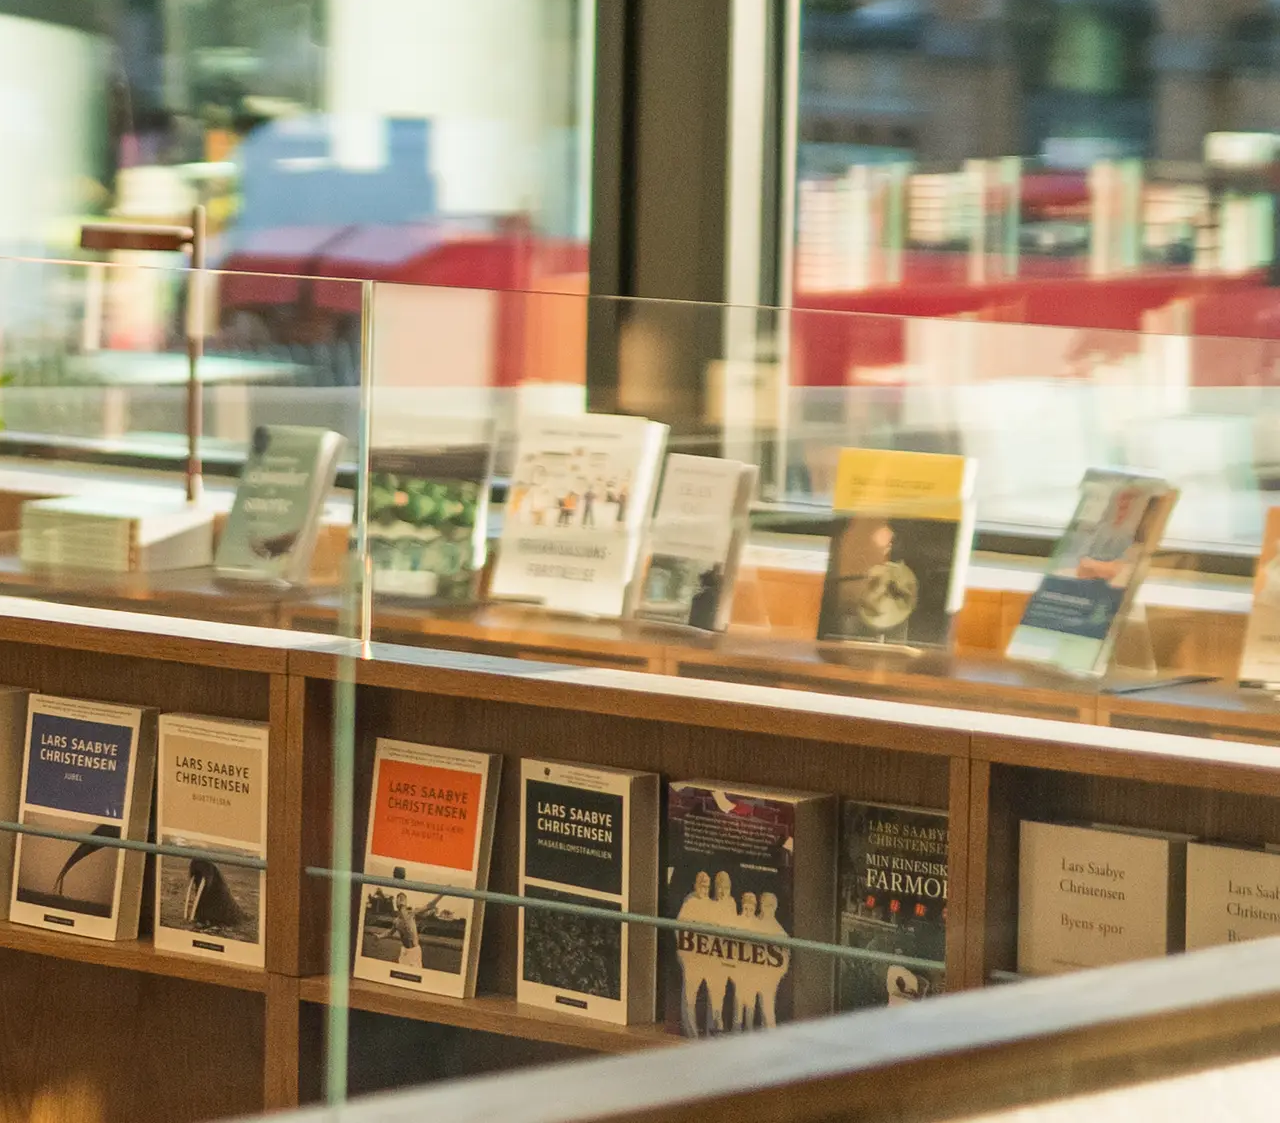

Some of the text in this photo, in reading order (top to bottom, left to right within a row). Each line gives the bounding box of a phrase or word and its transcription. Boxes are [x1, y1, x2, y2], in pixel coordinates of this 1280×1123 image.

[41, 733, 119, 756] LARS SAABYE
[40, 748, 117, 772] CHRISTENSEN
[176, 755, 250, 779] LARS SAABYE
[175, 771, 250, 794] CHRISTENSEN
[388, 779, 469, 805] LARS SAABYE
[388, 796, 467, 820] CHRISTENSEN
[537, 801, 612, 827] LARS SAABYE
[537, 817, 613, 843] CHRISTENSEN
[868, 819, 900, 835] LARS
[865, 853, 889, 868] MIN
[1061, 857, 1125, 881] Lars Saabye
[1060, 878, 1125, 901] Christensen
[1228, 879, 1252, 896] Lars
[1061, 913, 1124, 937] Byens spor
[678, 929, 784, 968] BEATLES
